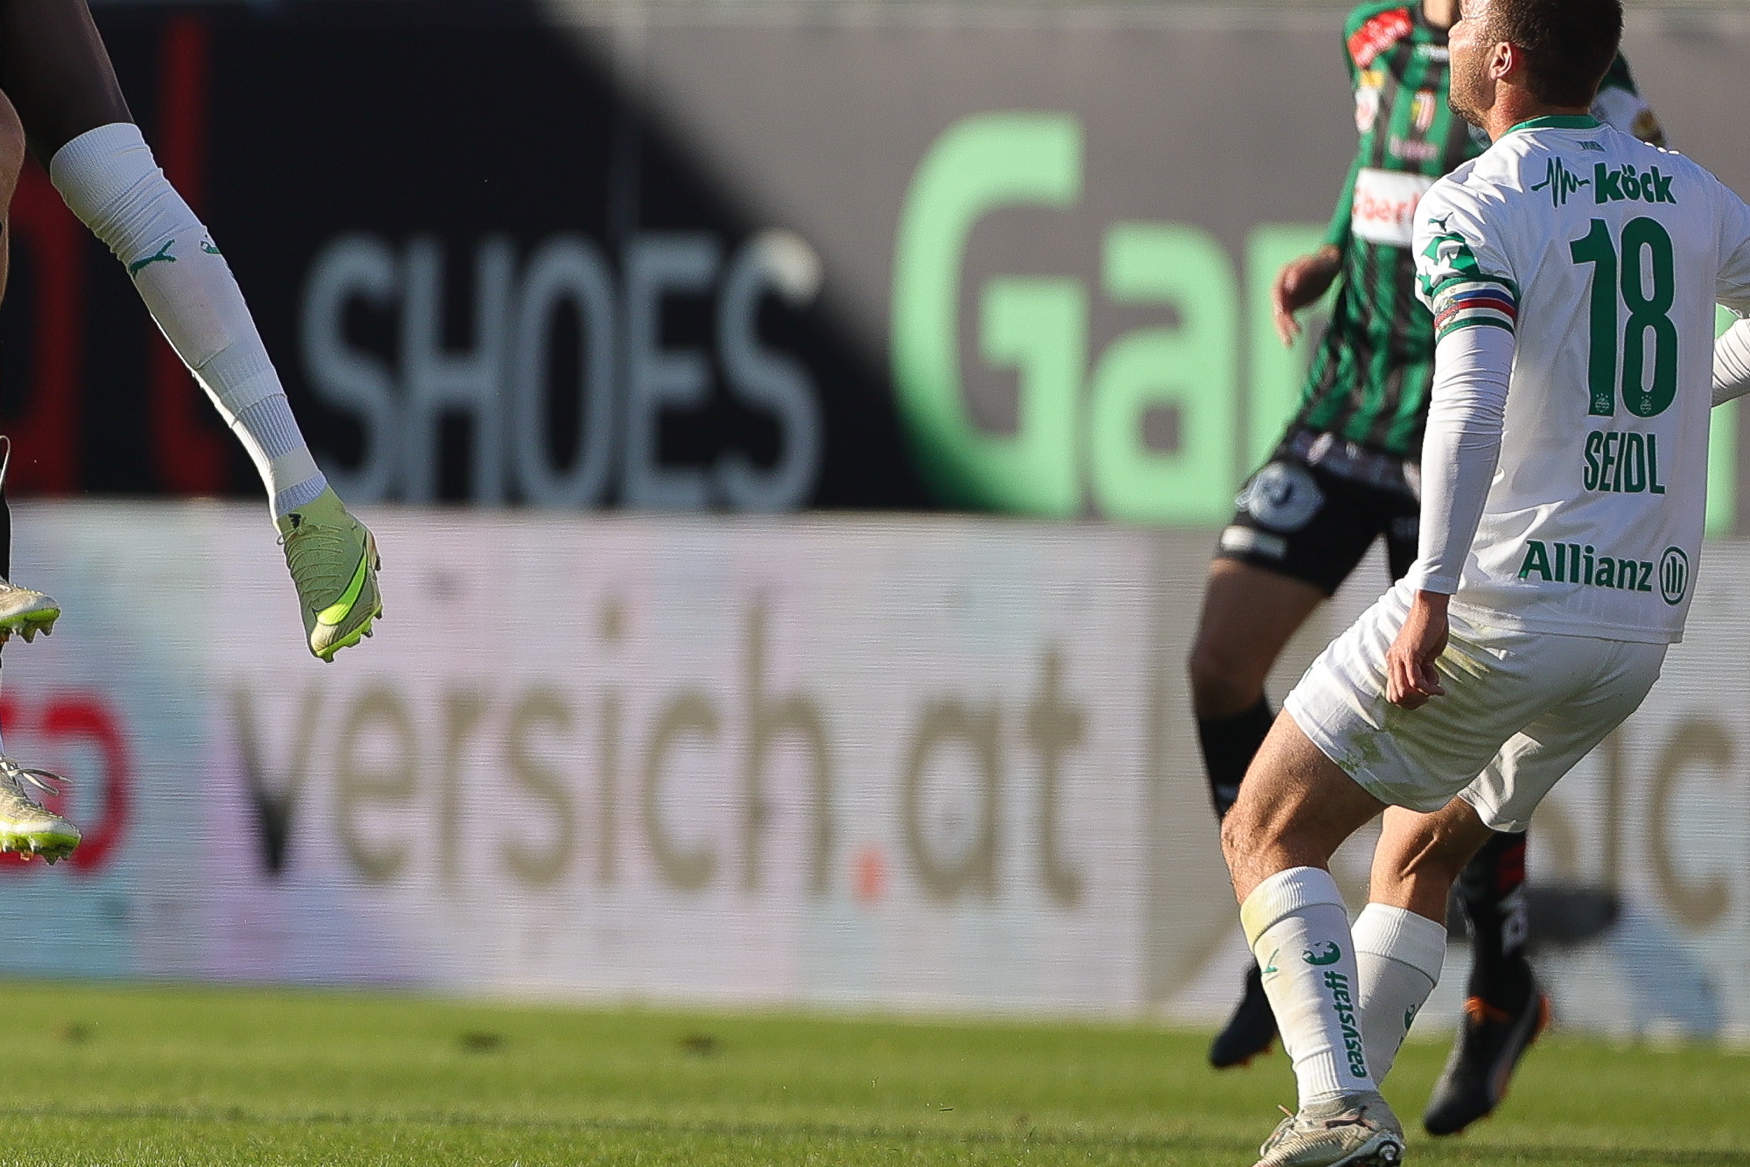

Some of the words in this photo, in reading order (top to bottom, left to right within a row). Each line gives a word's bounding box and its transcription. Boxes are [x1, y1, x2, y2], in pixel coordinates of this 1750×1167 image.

[300, 232, 823, 511] SHOES
[1570, 217, 1678, 418] 18
[1583, 430, 1666, 495] SEIDL
[1518, 539, 1653, 592] Allianz
[228, 589, 1095, 908] versich.at
[1324, 970, 1367, 1078] easystaff
